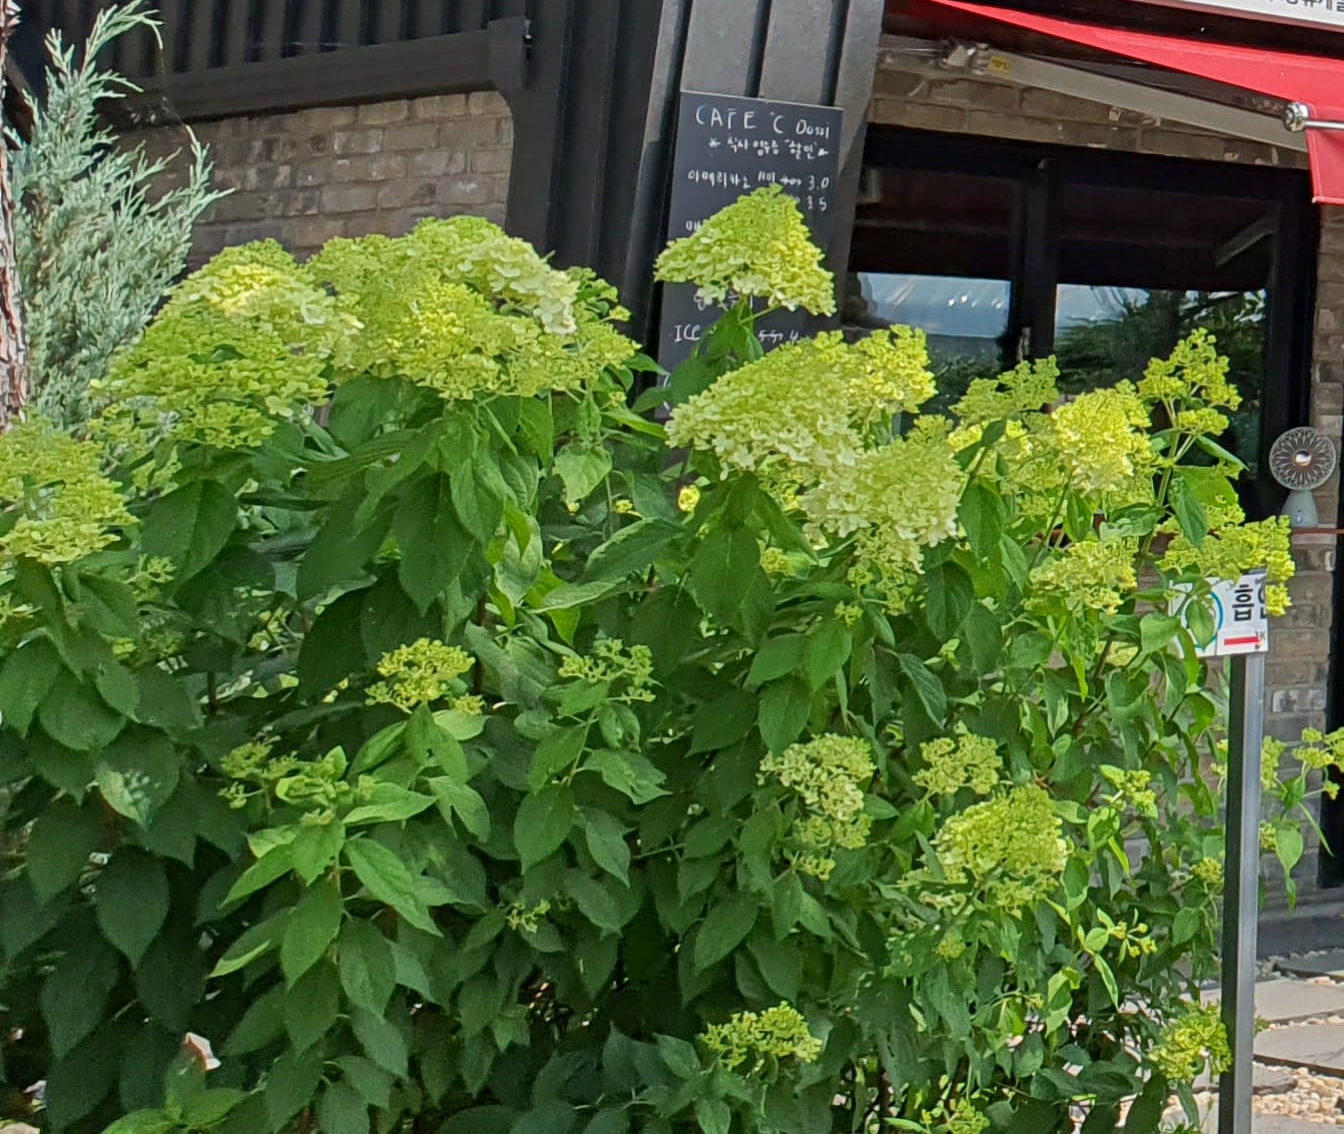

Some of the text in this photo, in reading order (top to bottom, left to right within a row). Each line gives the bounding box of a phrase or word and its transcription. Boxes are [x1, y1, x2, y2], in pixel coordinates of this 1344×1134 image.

[695, 107, 757, 130] CAFE
[808, 174, 830, 191] 3.0
[674, 323, 701, 342] ICE
